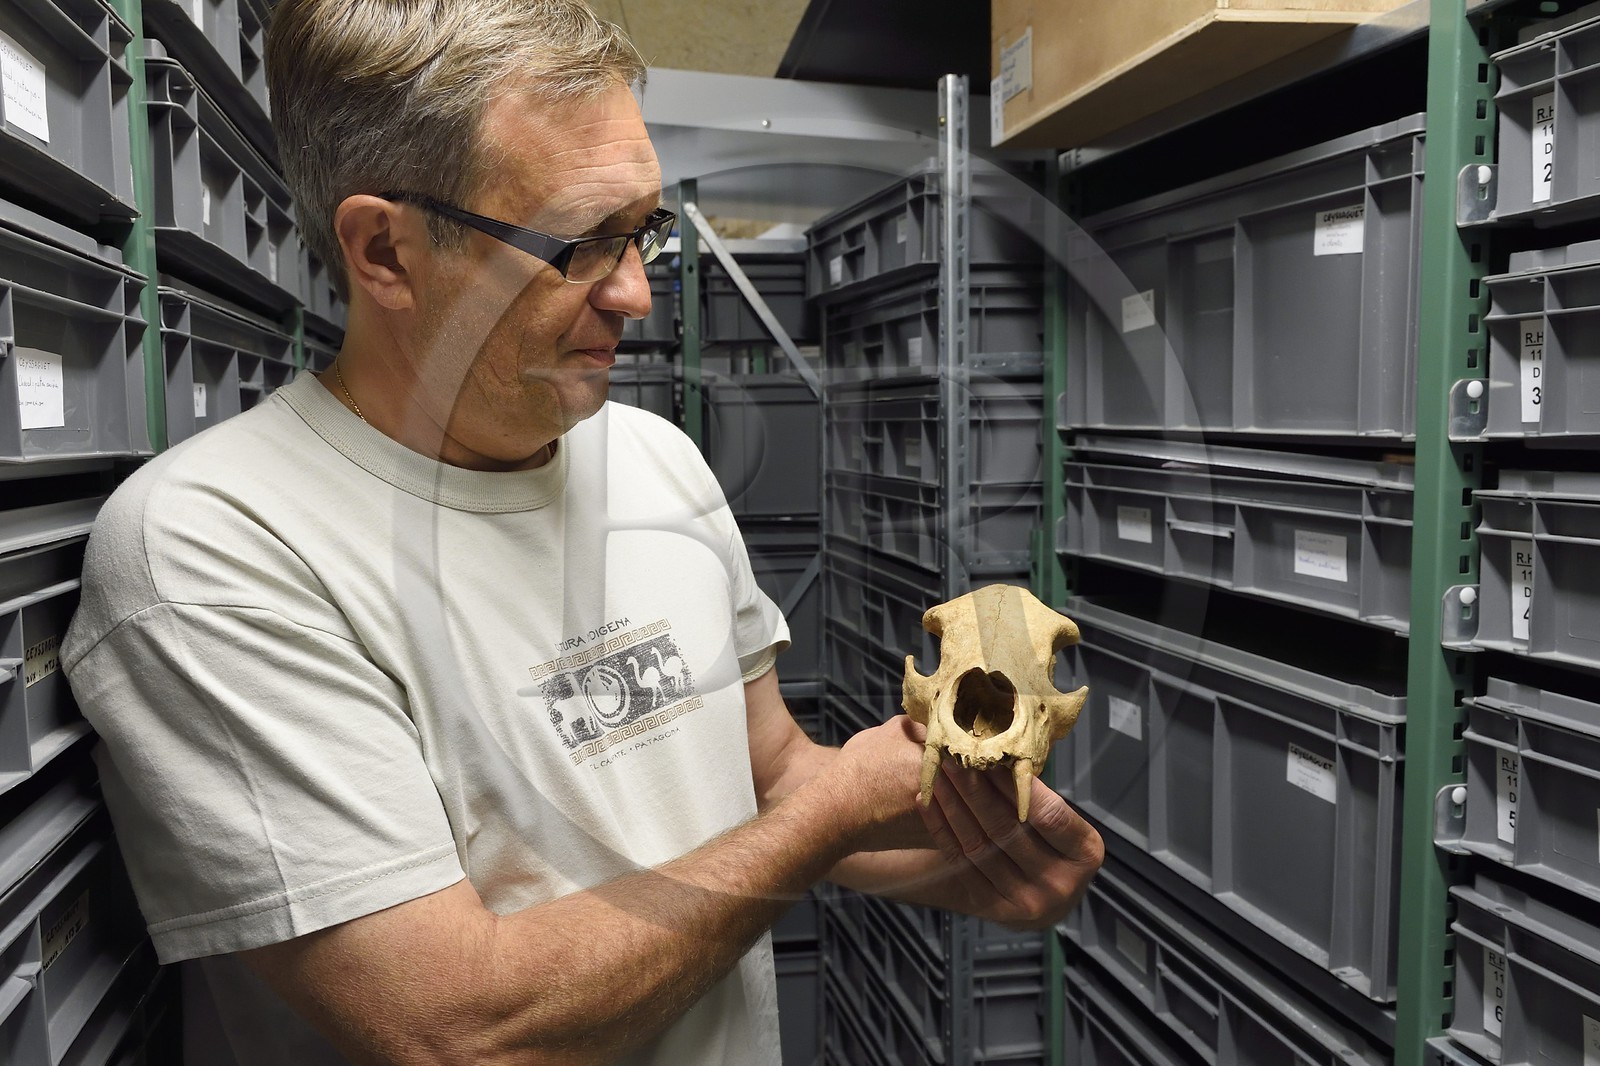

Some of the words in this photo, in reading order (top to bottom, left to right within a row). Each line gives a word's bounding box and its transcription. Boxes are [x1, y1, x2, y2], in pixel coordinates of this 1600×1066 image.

[1544, 143, 1553, 154] D
[1544, 162, 1552, 182] 2
[1533, 367, 1540, 378] D
[1532, 386, 1541, 405] 3
[1524, 586, 1531, 598] D
[587, 617, 632, 642] DIGENA
[1509, 792, 1516, 803] D
[1509, 810, 1516, 828] 5
[1496, 986, 1502, 998] D
[1495, 1006, 1503, 1023] 6
